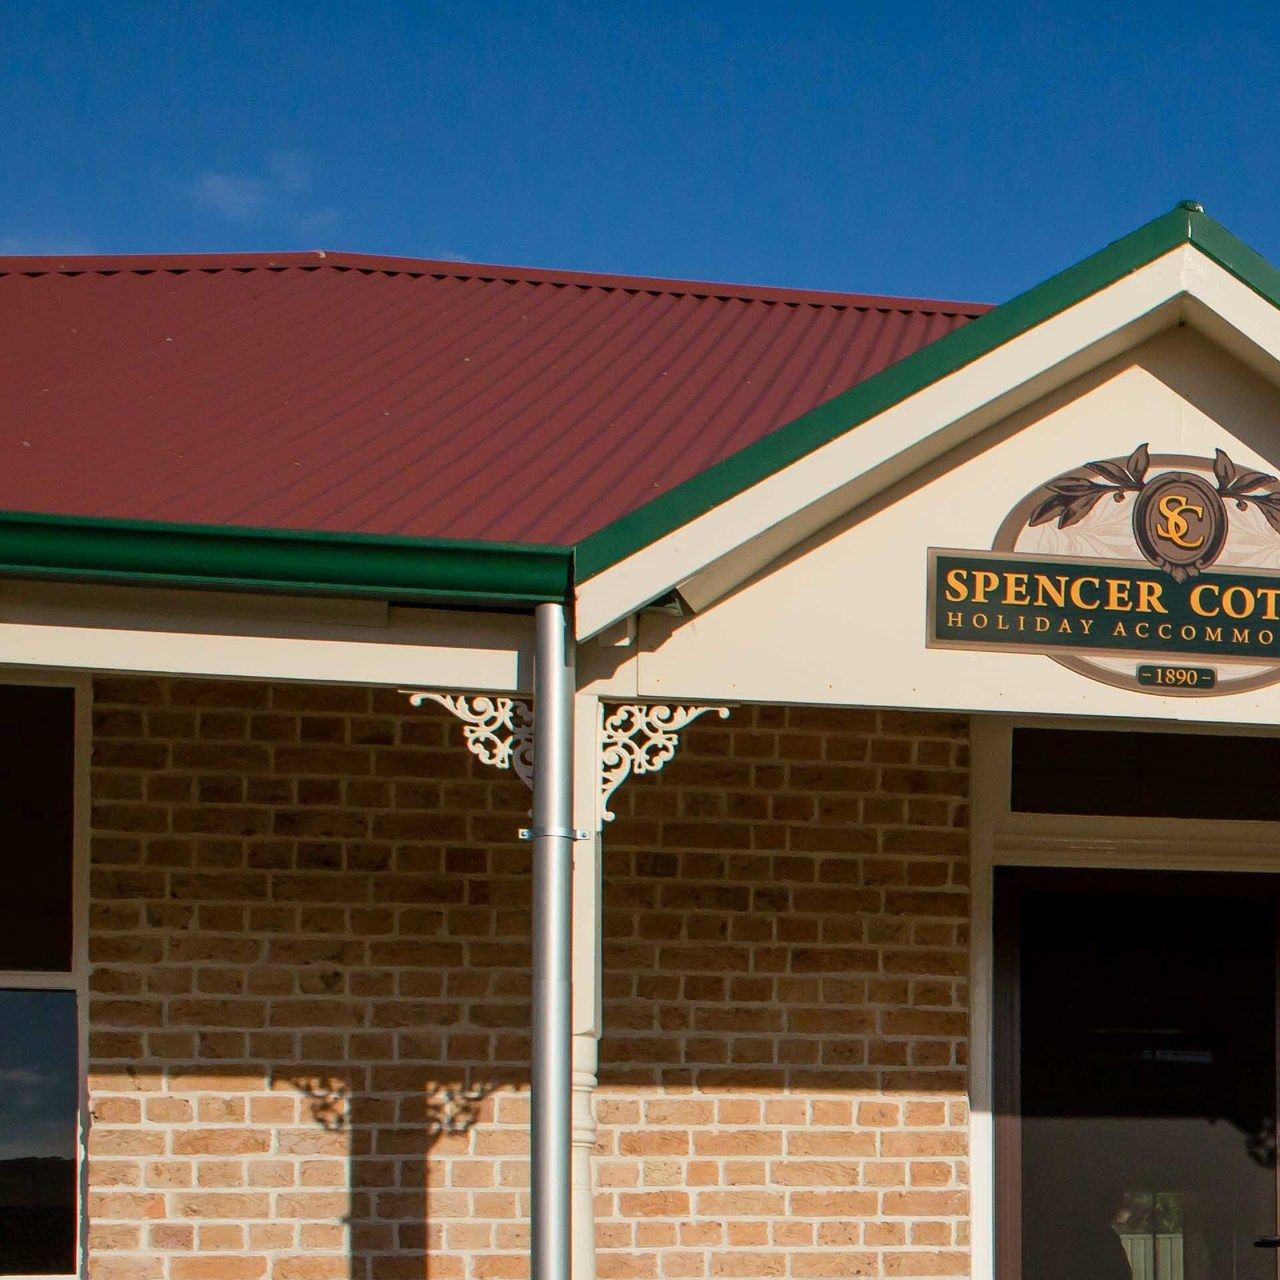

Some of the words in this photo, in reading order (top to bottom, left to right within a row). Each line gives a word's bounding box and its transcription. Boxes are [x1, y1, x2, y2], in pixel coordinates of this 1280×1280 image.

[1156, 494, 1205, 548] SC
[945, 569, 1168, 614] SPENCER
[946, 611, 1095, 634] HOLIDAY
